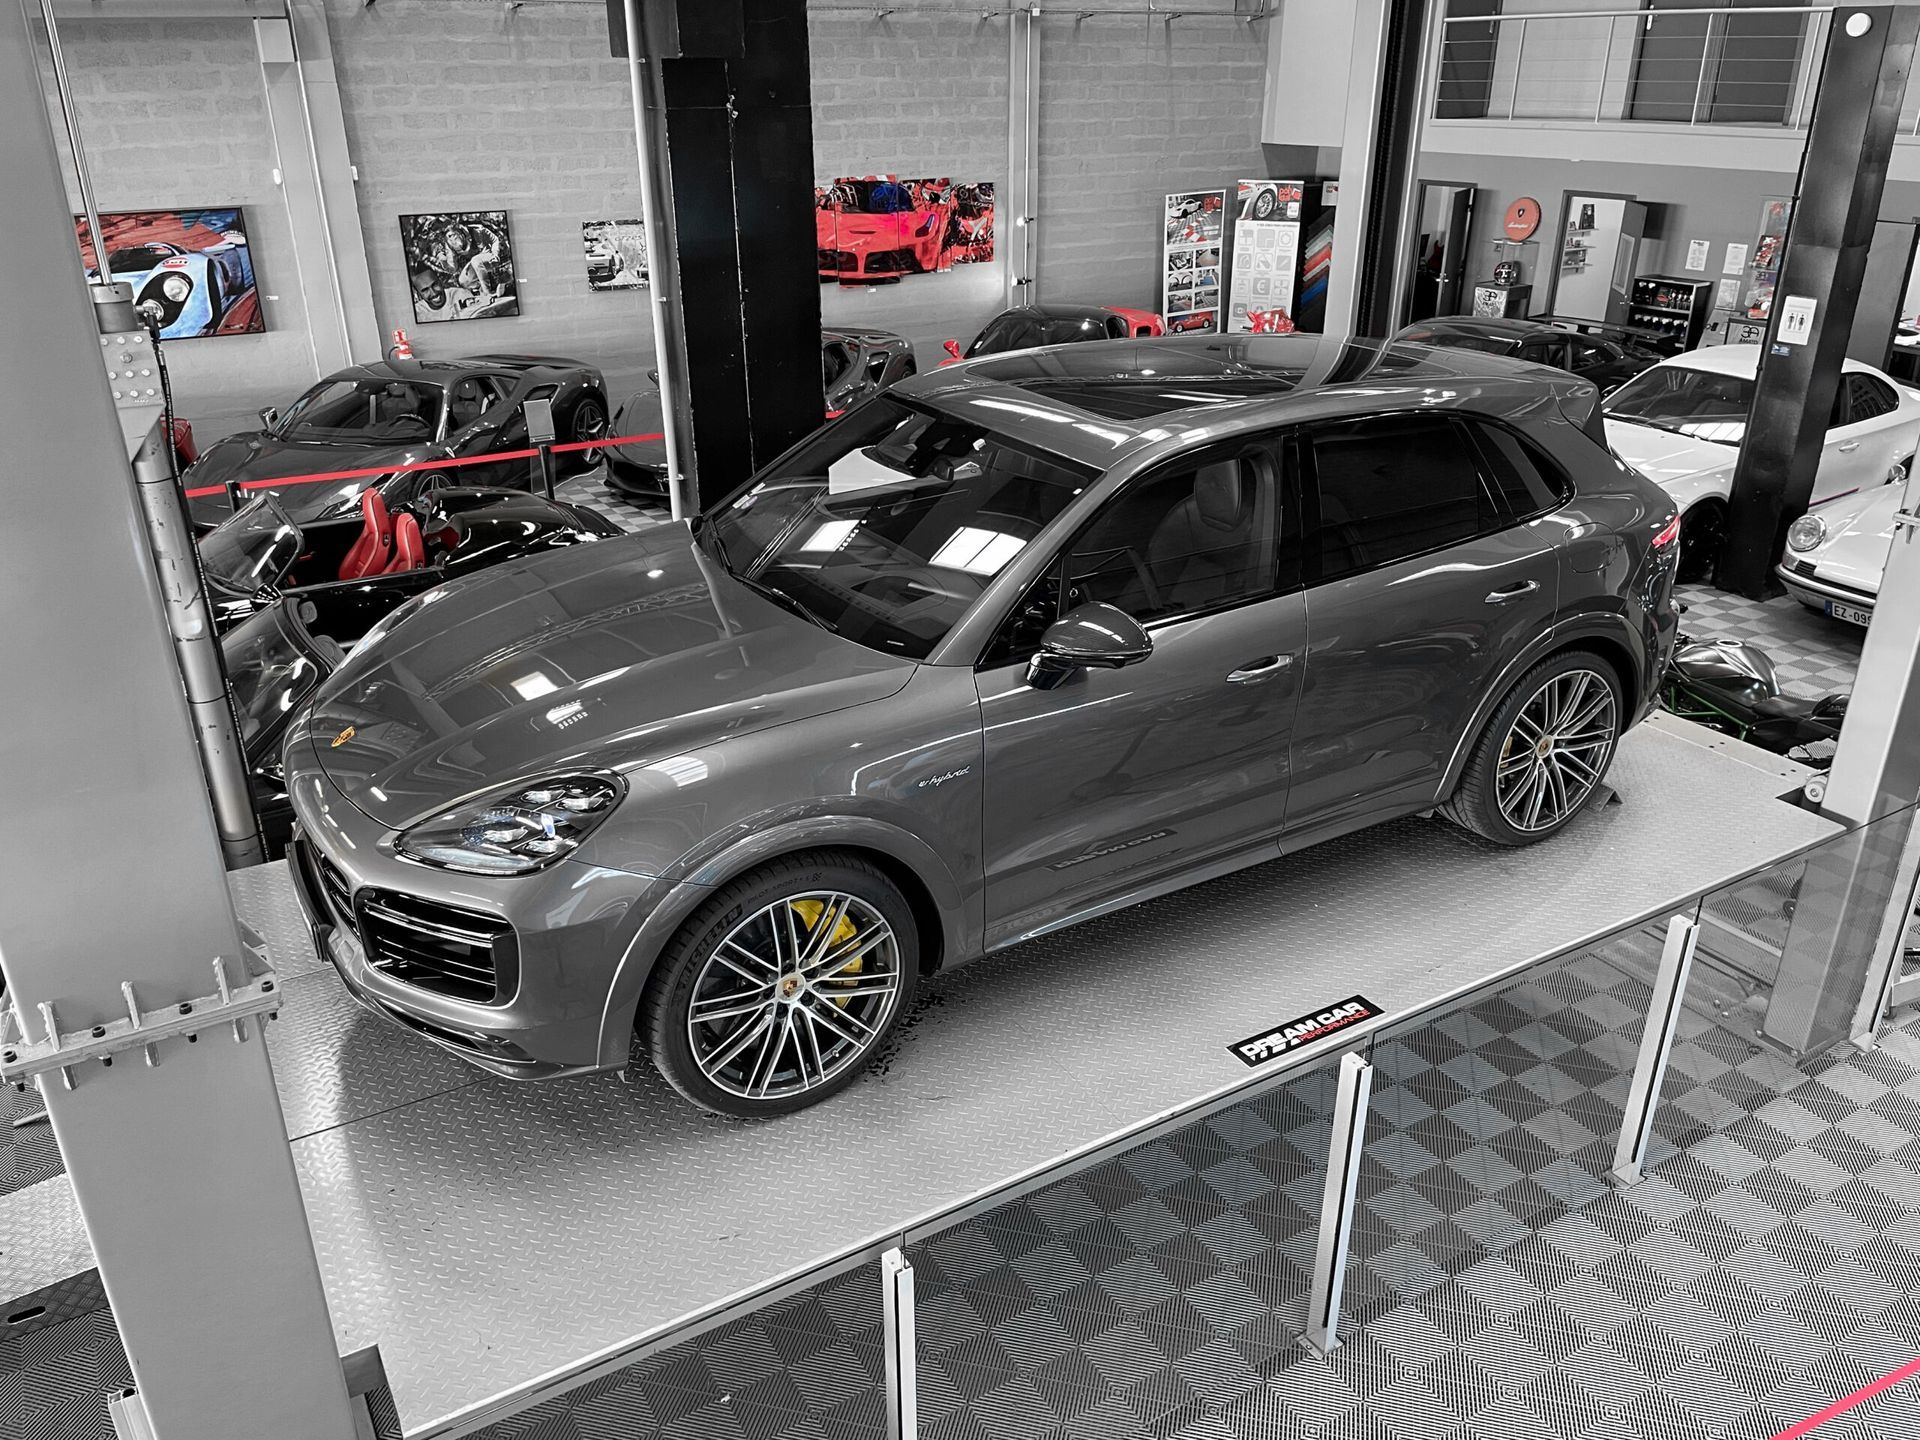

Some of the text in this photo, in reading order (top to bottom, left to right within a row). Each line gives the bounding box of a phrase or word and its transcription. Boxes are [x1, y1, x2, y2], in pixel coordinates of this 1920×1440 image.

[681, 903, 743, 989] MICHELIN
[1239, 1001, 1365, 1060] DREAM CAR
[1298, 1010, 1370, 1042] PERFORMANCE
